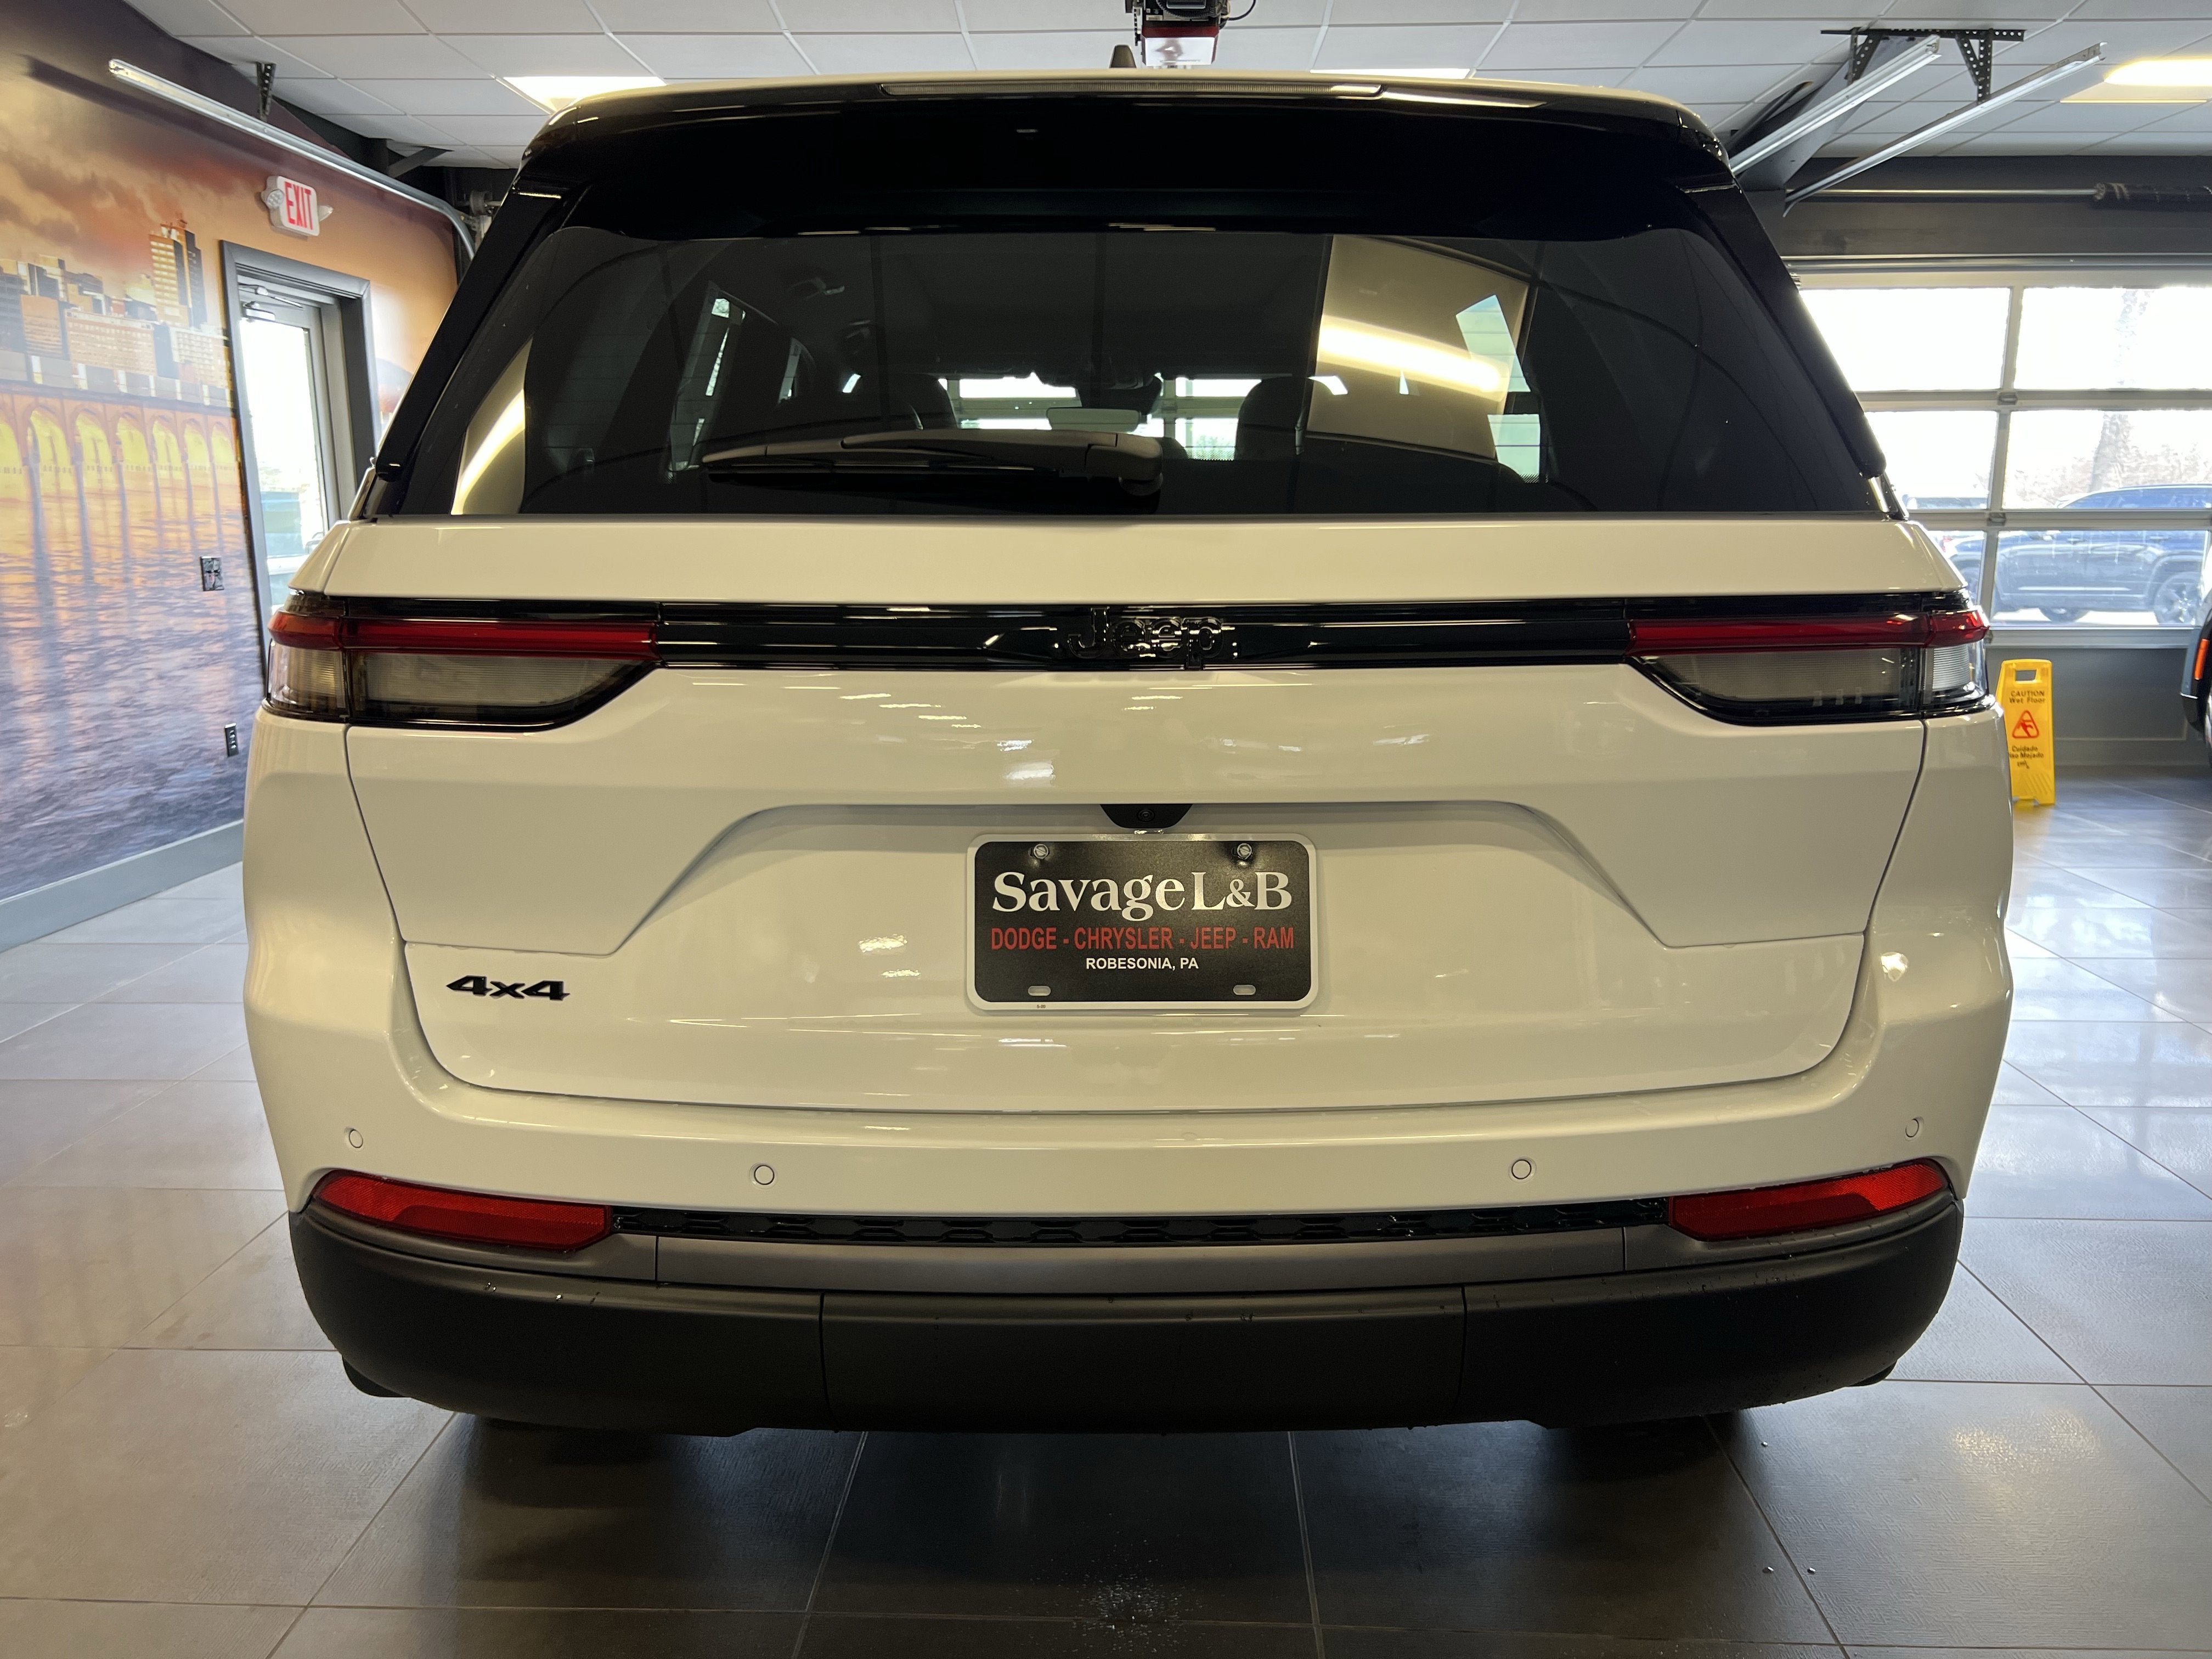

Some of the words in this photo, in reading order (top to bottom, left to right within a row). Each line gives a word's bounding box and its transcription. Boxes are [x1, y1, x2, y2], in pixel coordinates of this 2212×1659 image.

[284, 181, 313, 230] EXIT
[1068, 606, 1224, 670] Jeep
[992, 871, 1186, 922] Savage
[1191, 871, 1293, 912] L&B
[991, 927, 1058, 950] DODGE
[1074, 927, 1173, 949] CHRYSLER
[1190, 926, 1236, 949] JEEP
[1254, 926, 1294, 948] RAM
[1086, 957, 1176, 971] ROBESONIA,
[1180, 957, 1199, 969] PA
[446, 975, 571, 1001] 4x4
